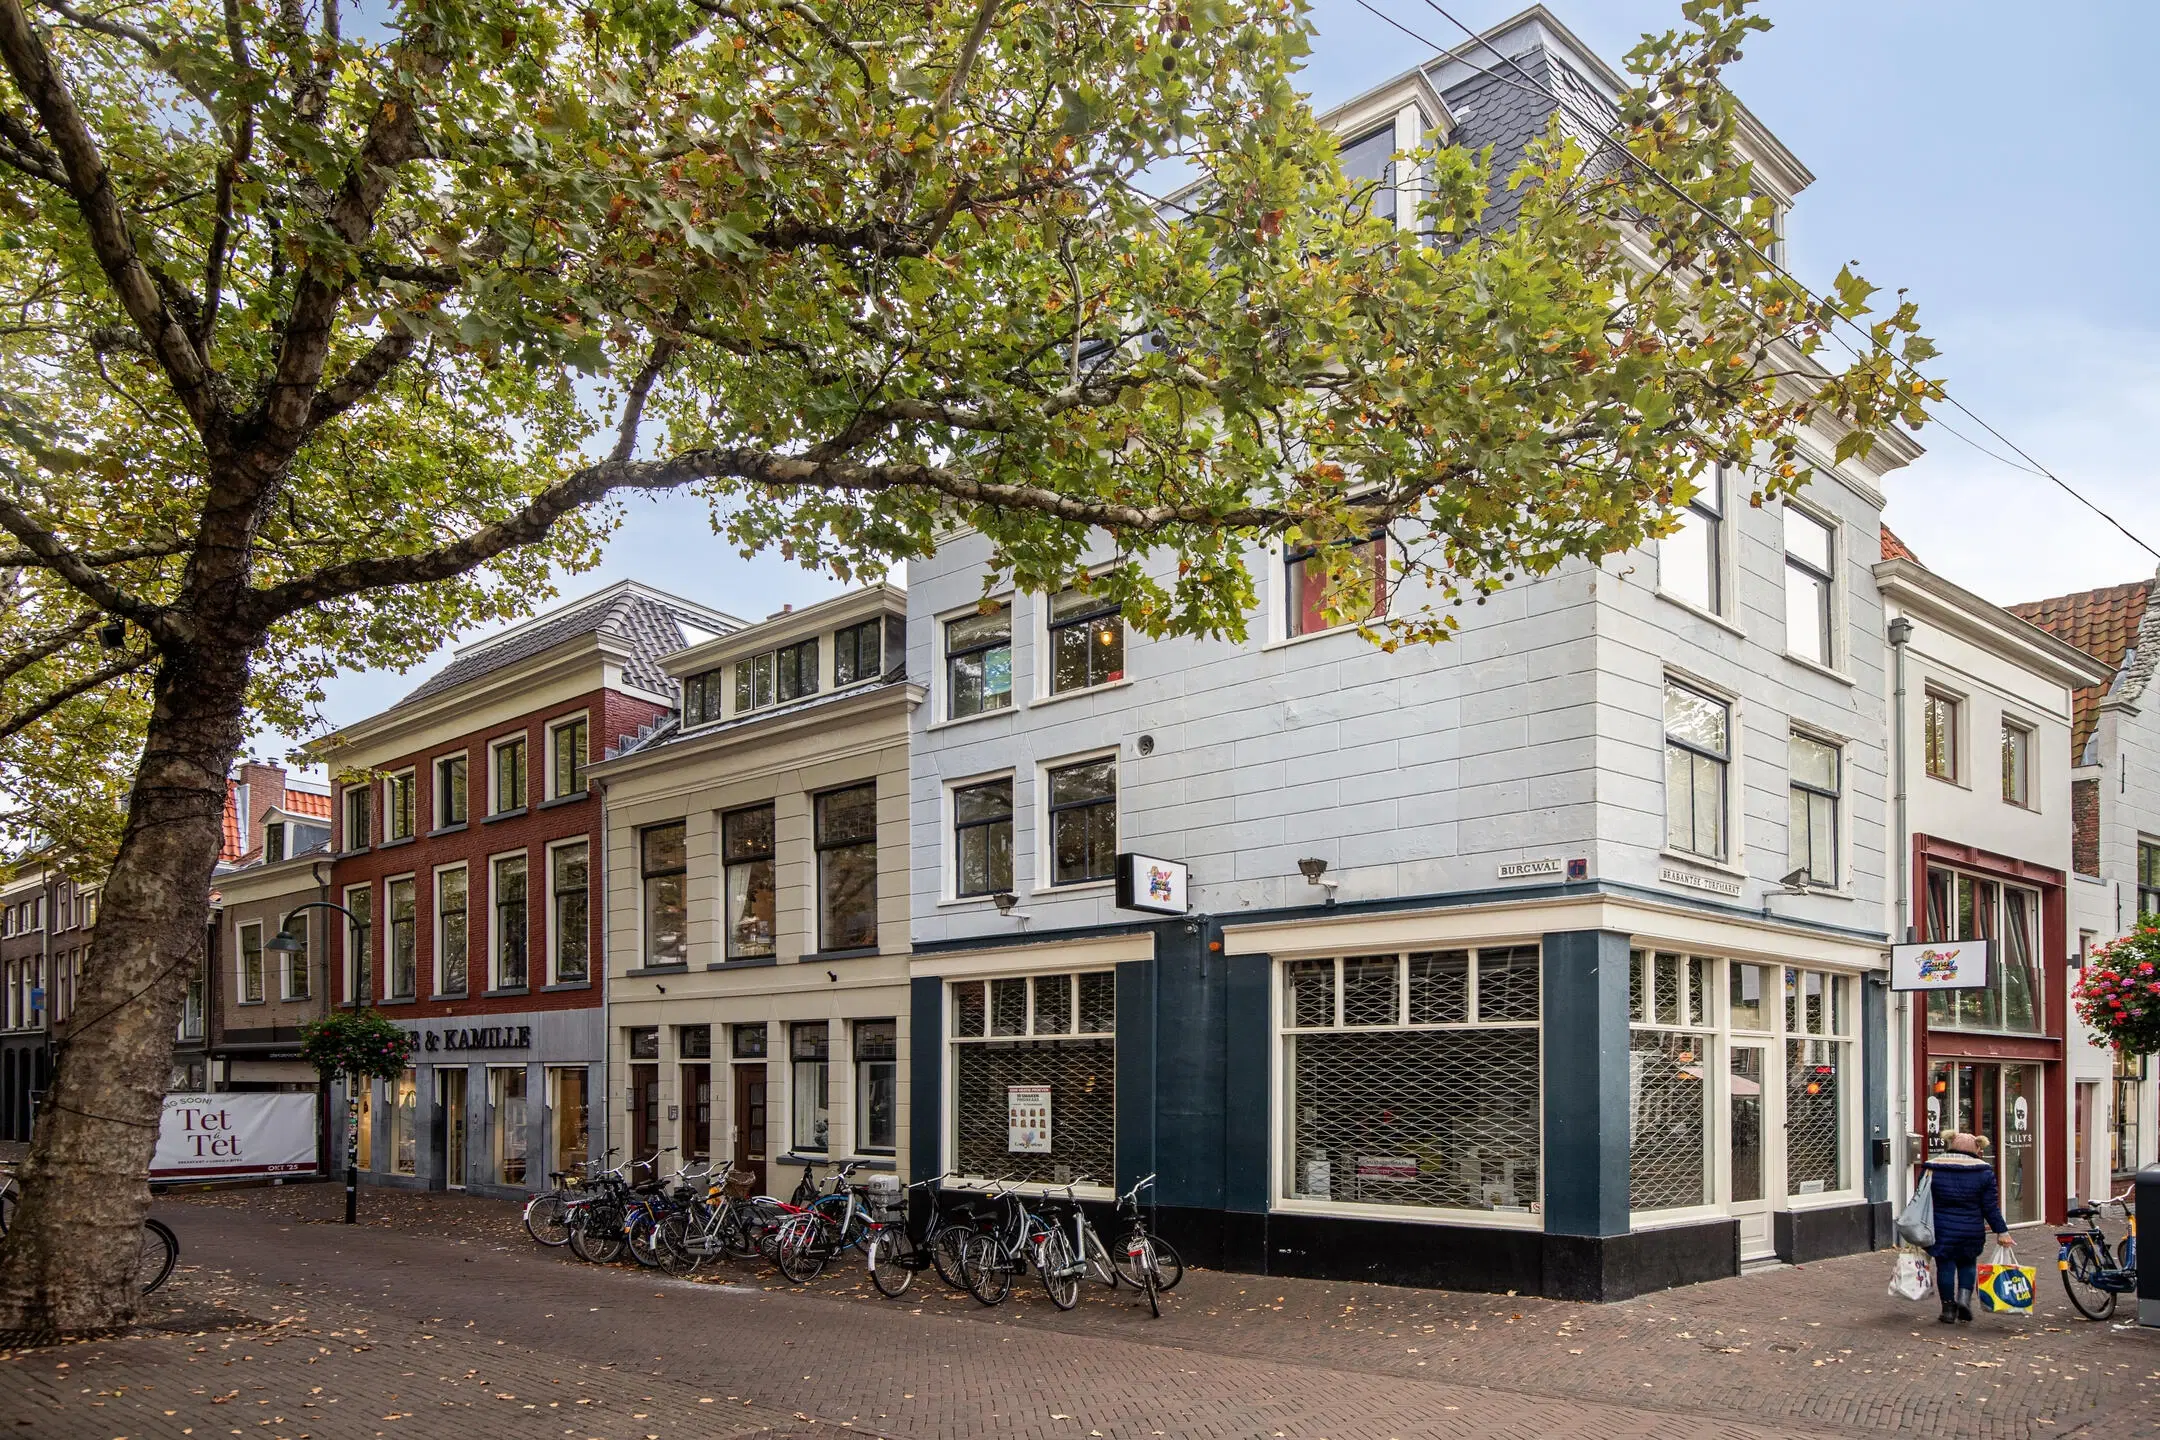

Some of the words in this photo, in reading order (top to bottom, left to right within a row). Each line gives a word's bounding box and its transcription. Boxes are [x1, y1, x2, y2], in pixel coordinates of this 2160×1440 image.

[1501, 862, 1559, 875] BURGWAL
[1663, 870, 1701, 886] BRABANTSE
[424, 1030, 439, 1051] &
[443, 1026, 531, 1050] KAMILLE
[180, 1097, 212, 1105] SOON!
[176, 1109, 232, 1131] Tet
[187, 1135, 243, 1157] Tet
[267, 1164, 284, 1172] OKT
[2002, 1277, 2029, 1296] Full
[2011, 1276, 2022, 1284] Go
[2016, 1291, 2031, 1301] Lidl
